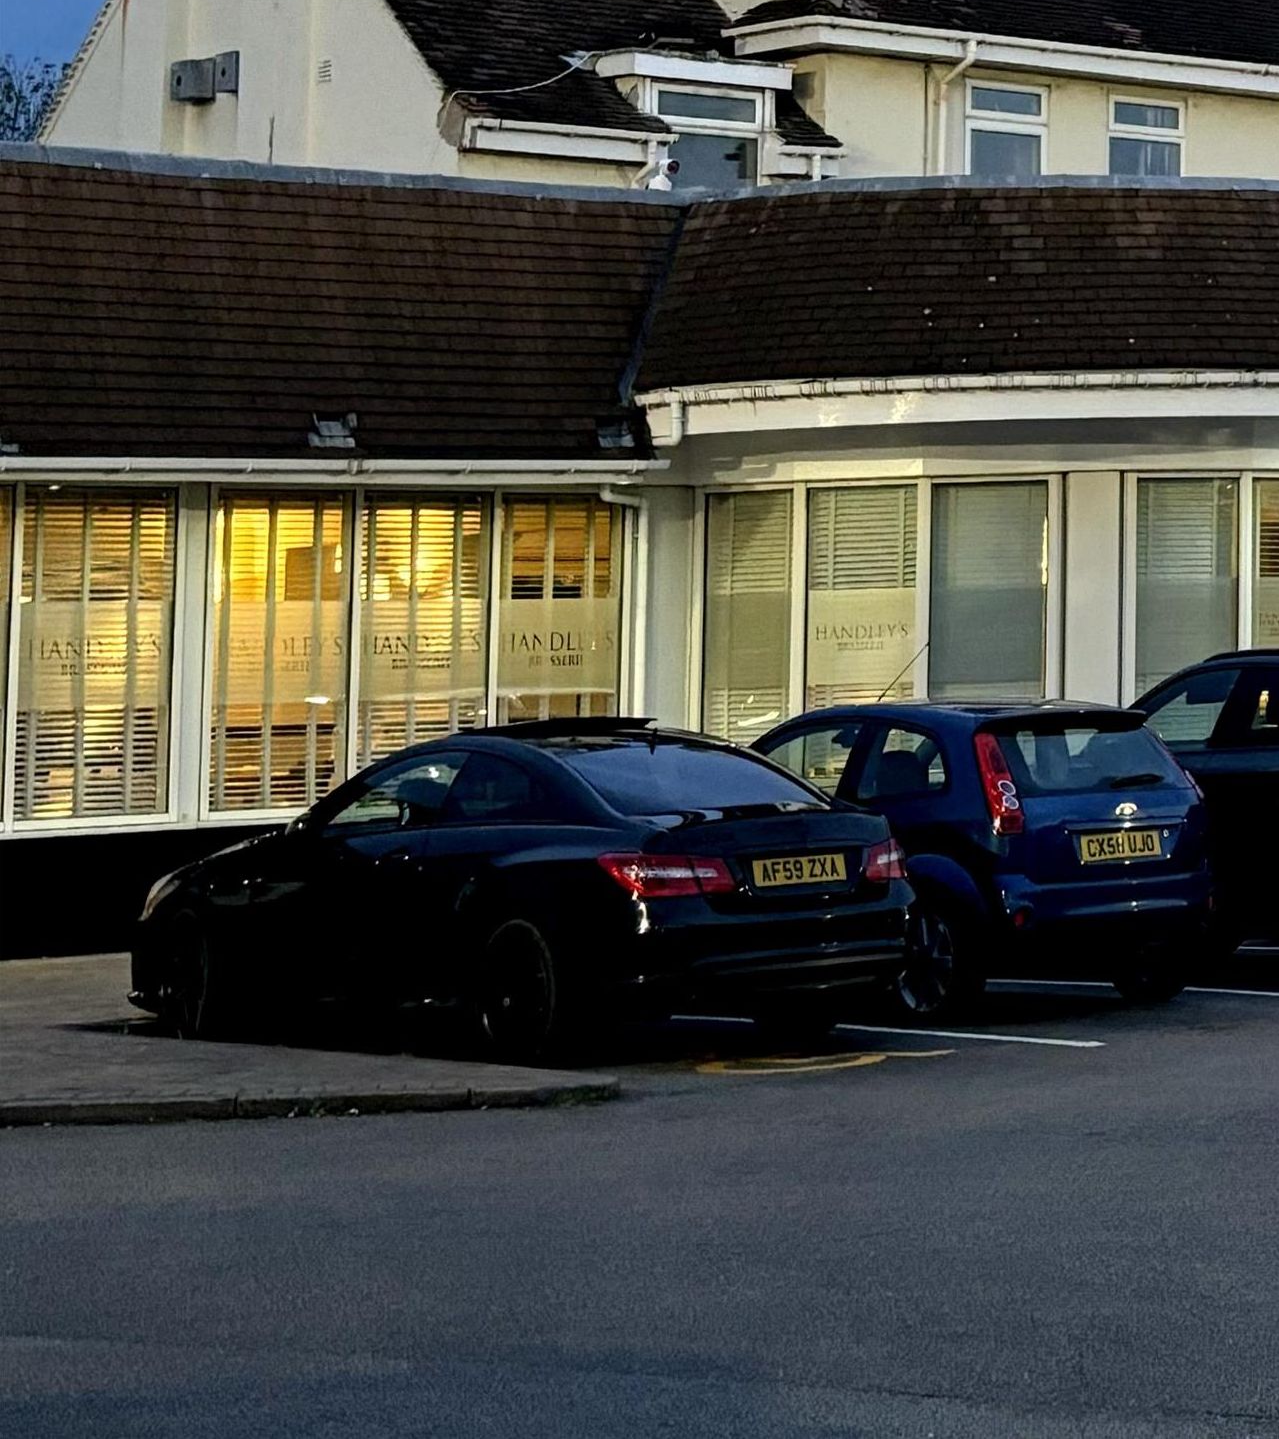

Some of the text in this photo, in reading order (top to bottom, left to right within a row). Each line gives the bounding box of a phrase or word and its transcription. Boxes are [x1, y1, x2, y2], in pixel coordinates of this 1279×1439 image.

[1128, 833, 1155, 853] UJO
[762, 856, 840, 882] AF59 ZXA
